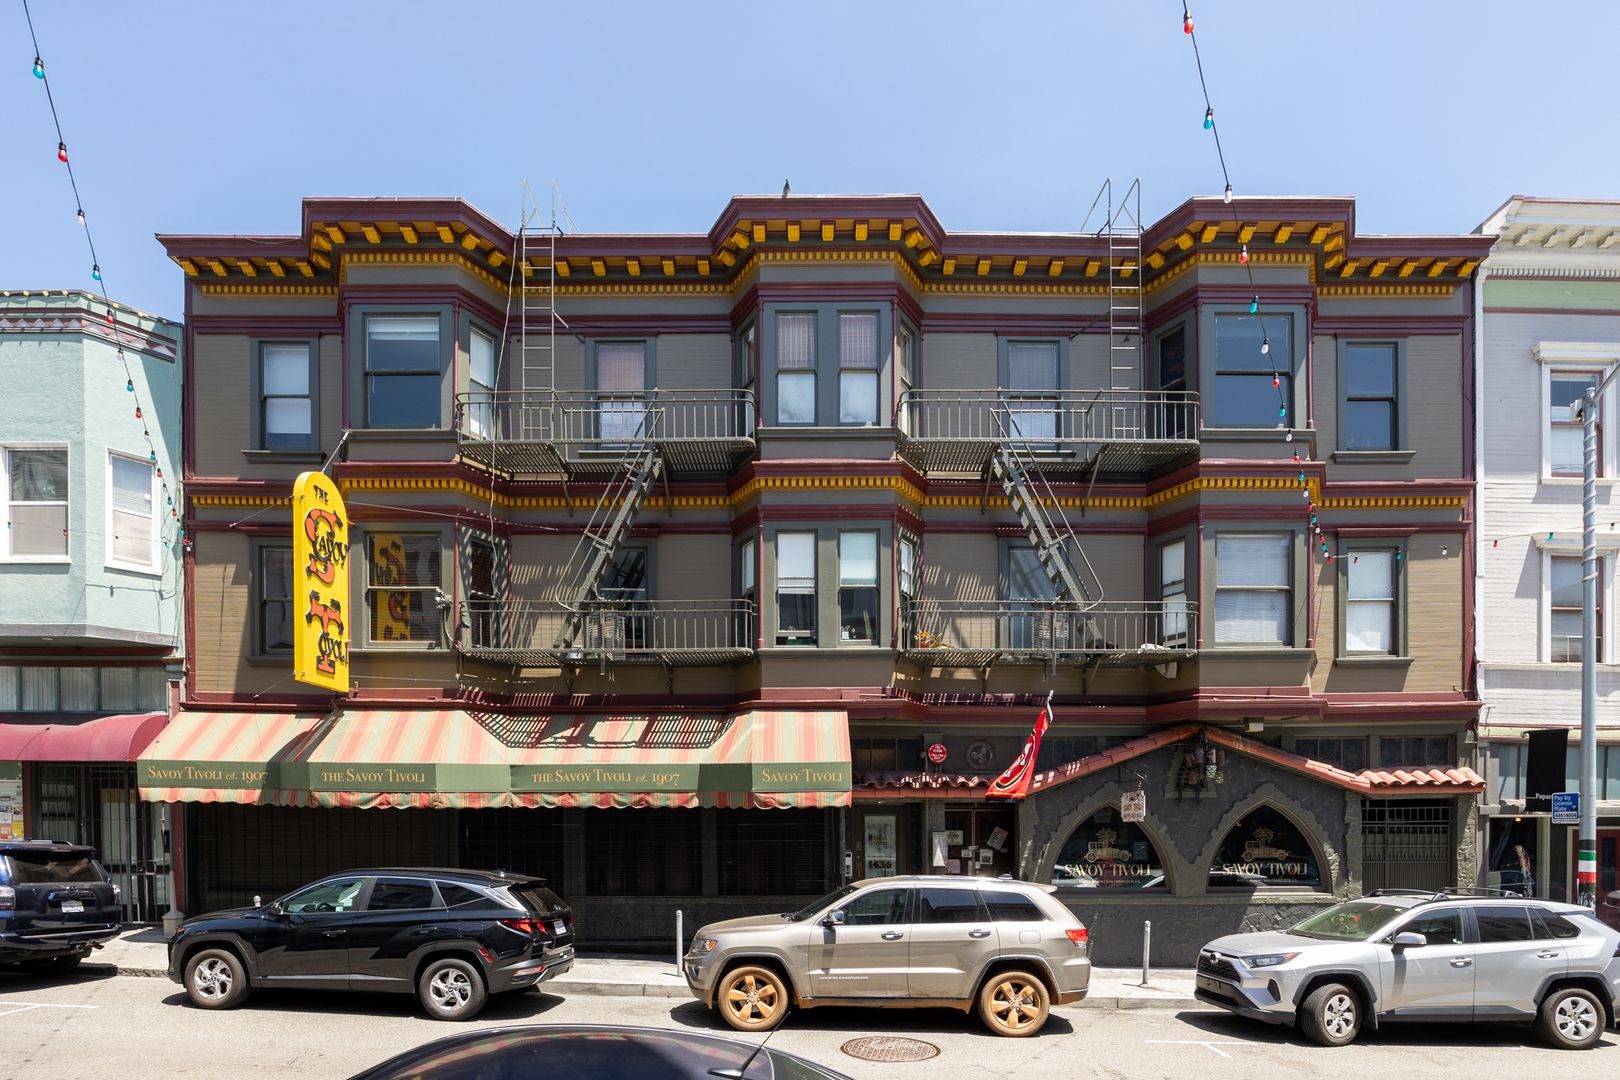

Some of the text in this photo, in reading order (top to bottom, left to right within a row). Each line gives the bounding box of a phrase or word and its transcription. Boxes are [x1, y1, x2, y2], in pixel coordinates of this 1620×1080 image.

[313, 485, 328, 500] THE
[241, 771, 268, 784] 1907
[321, 772, 345, 783] THE
[531, 773, 553, 783] THE
[635, 774, 648, 783] est.
[651, 772, 680, 786] 1907
[1064, 863, 1151, 877] SAVOY TIVOLI
[1222, 862, 1308, 876] SAVOY TIVOLI
